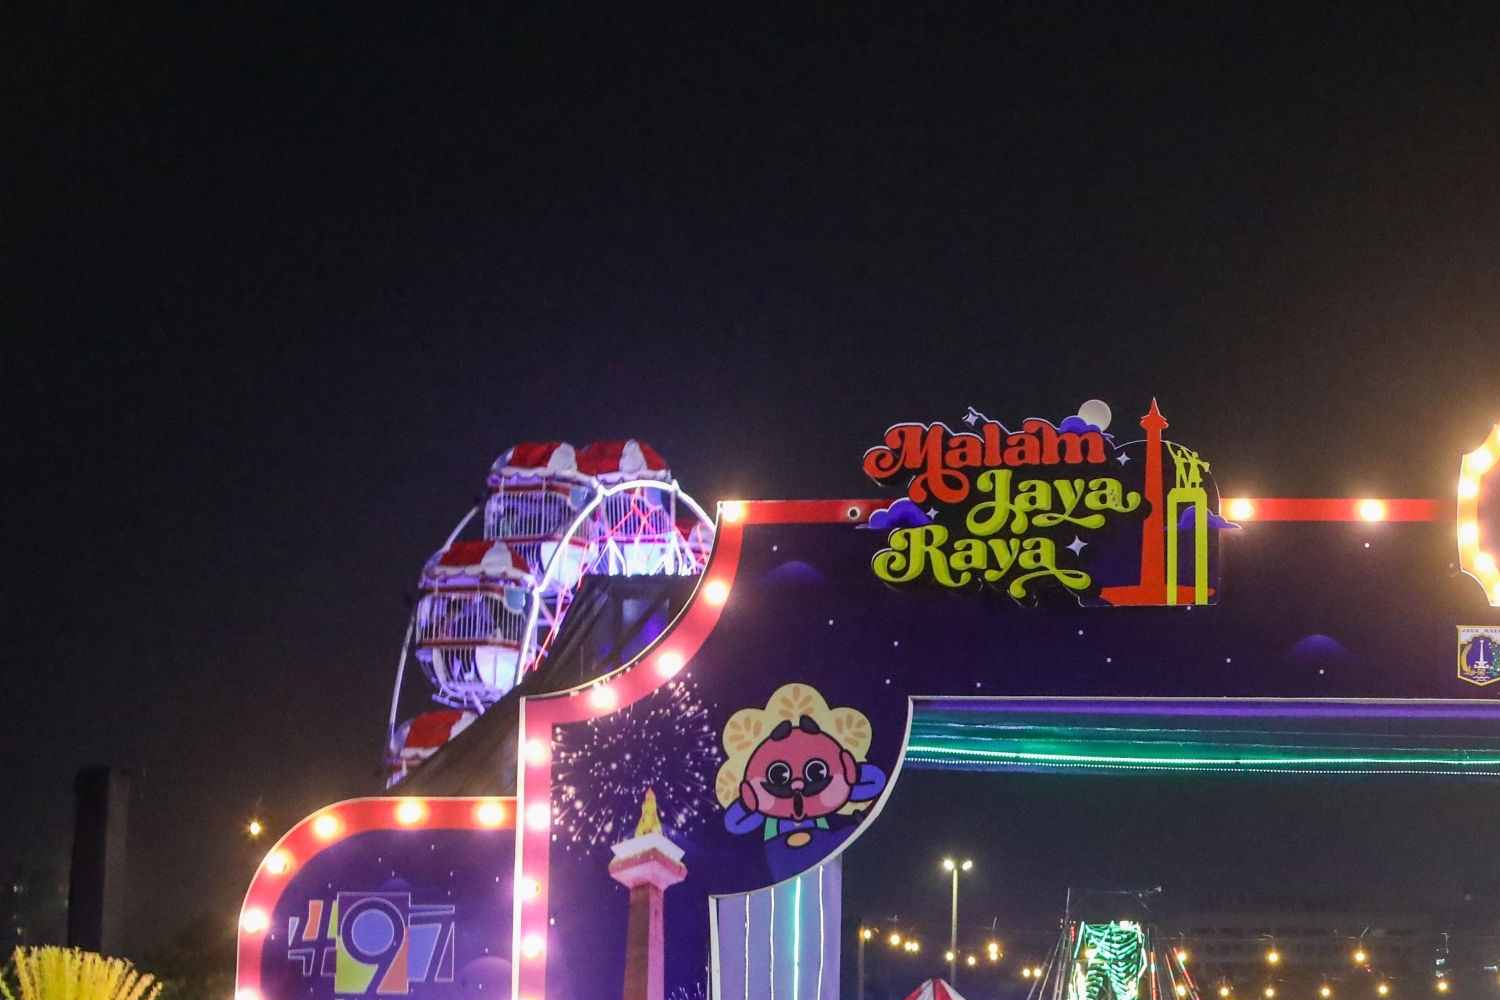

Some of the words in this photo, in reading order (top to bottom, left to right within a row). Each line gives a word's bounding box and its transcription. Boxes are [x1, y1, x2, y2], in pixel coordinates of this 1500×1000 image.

[863, 418, 1107, 503] Malam
[966, 469, 1141, 535] Jaya
[872, 524, 1092, 598] Raya
